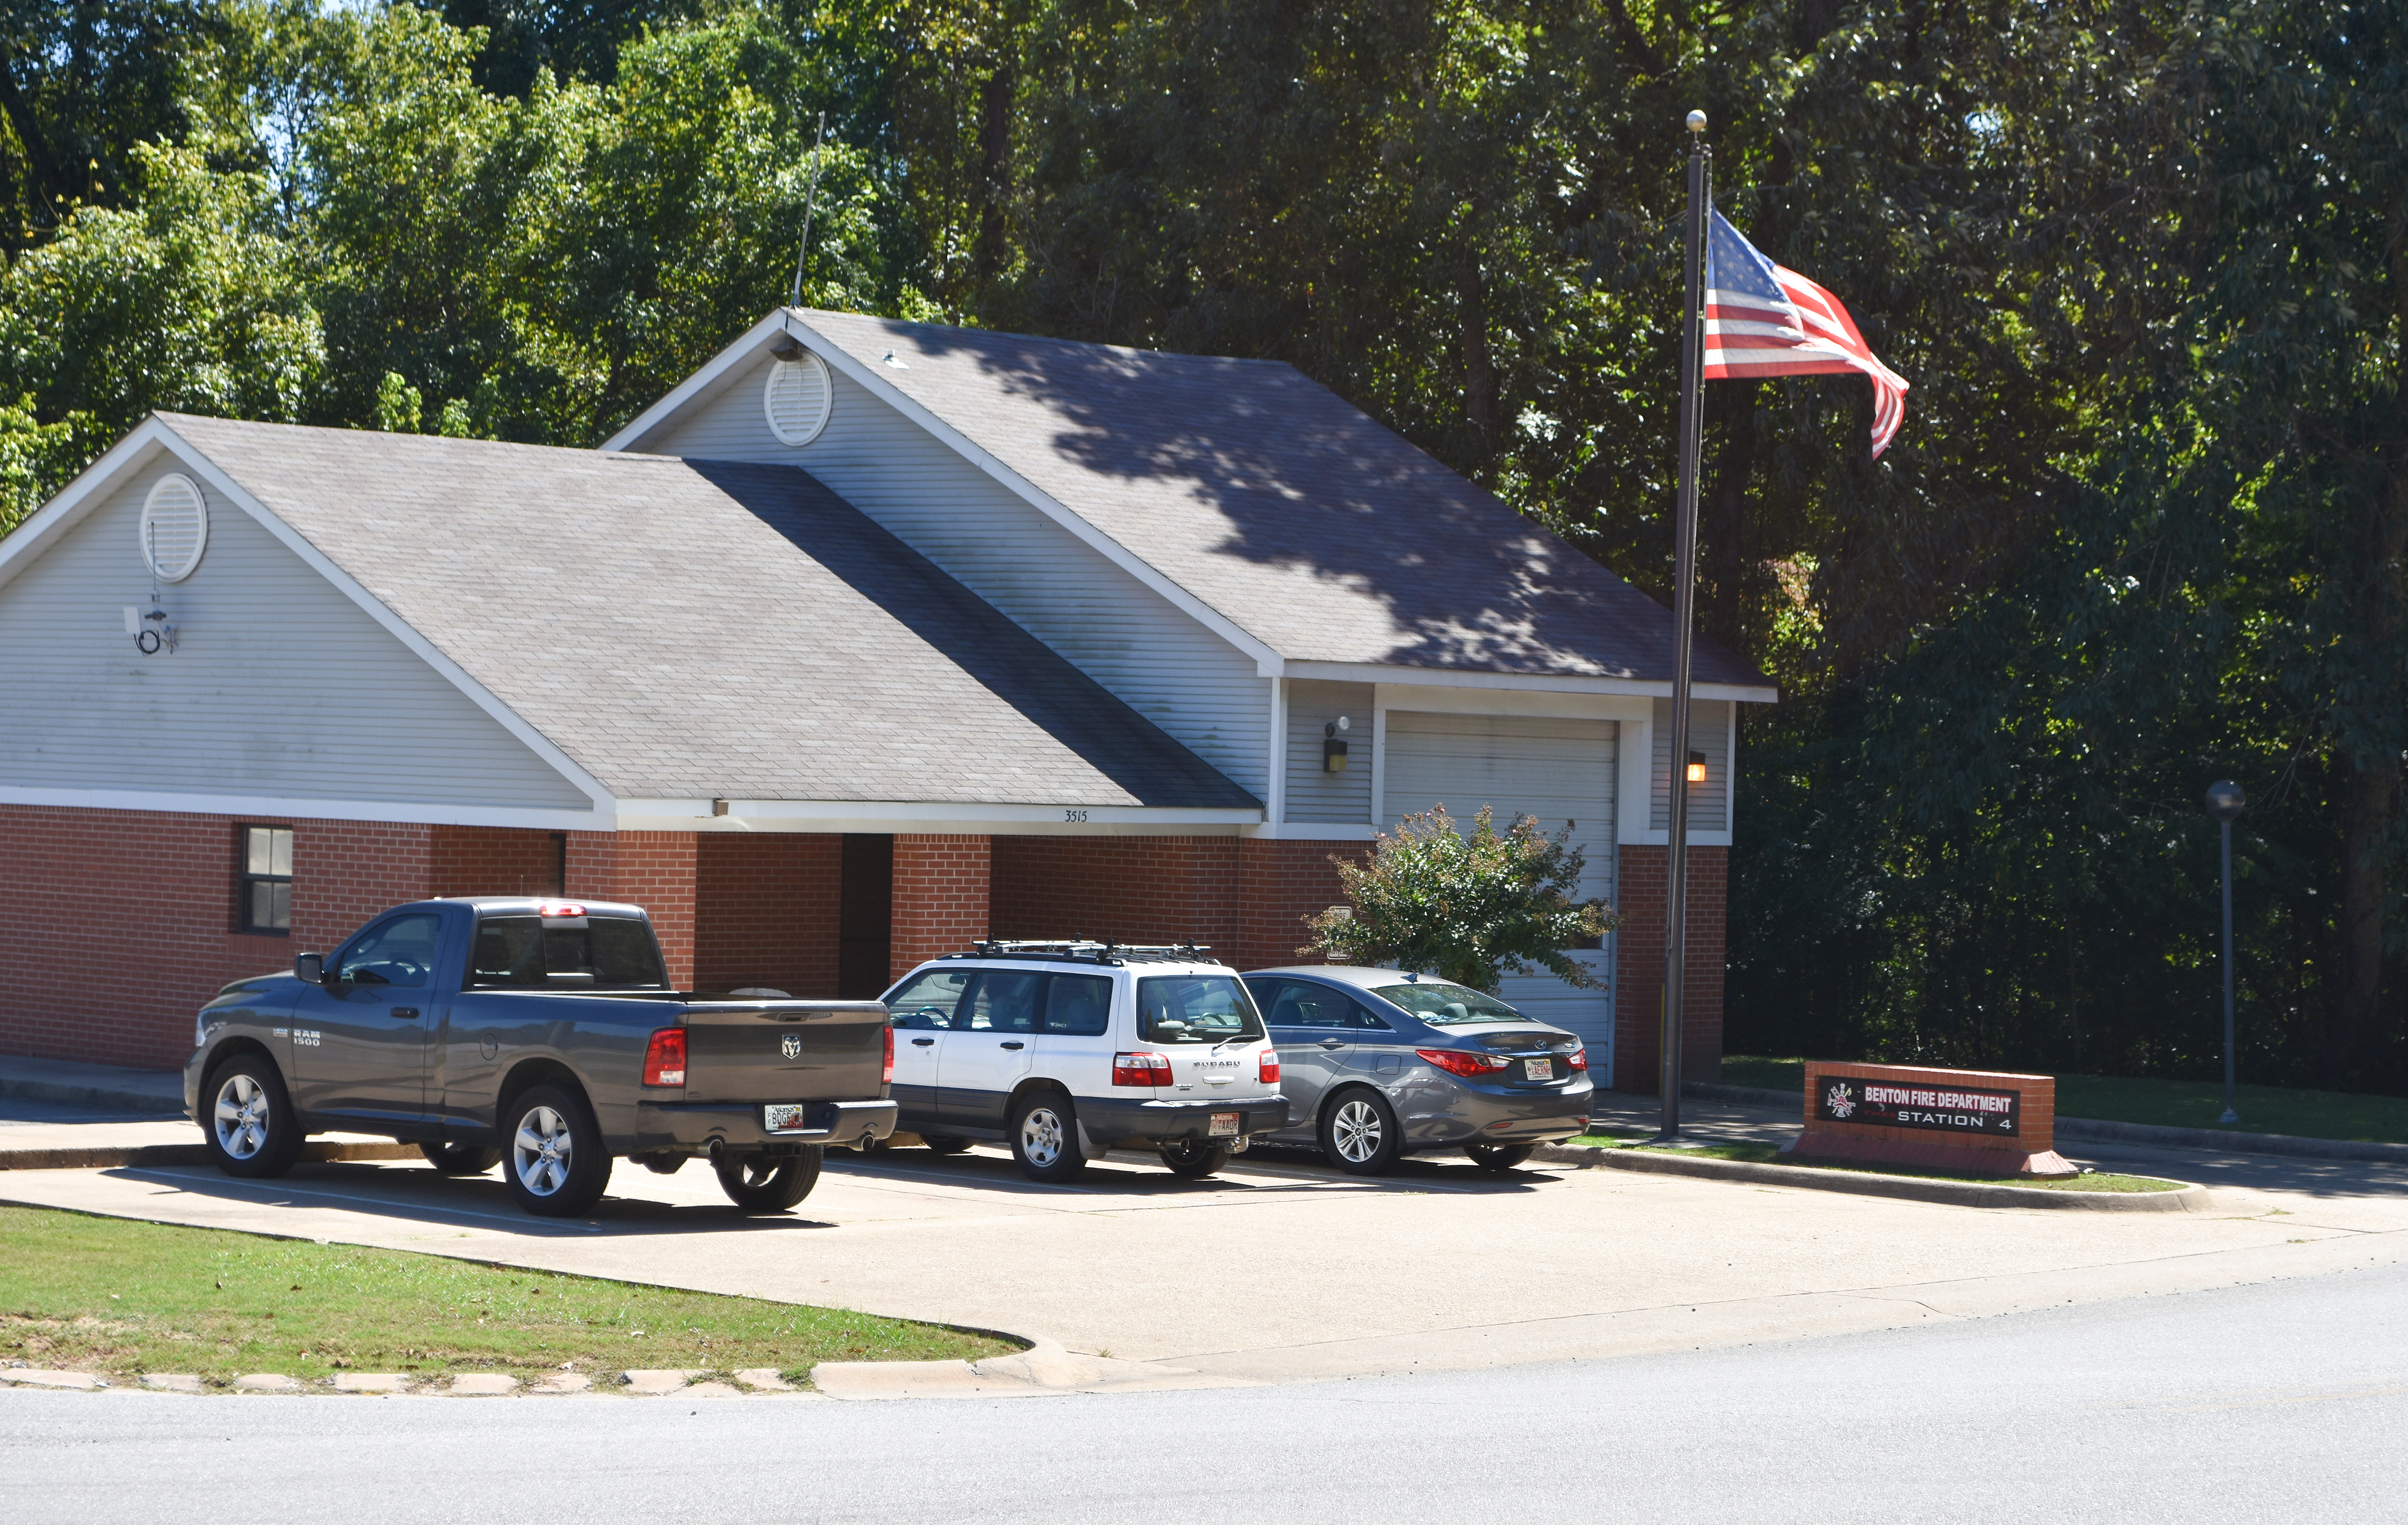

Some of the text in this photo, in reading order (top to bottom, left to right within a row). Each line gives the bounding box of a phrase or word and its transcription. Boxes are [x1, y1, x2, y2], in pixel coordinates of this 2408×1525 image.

[1064, 810, 1087, 822] 3515
[294, 1029, 320, 1039] RAM
[294, 1037, 320, 1046] 1500
[1865, 1086, 2012, 1113] BENTON FIRE DEPARTMENT
[1898, 1111, 2012, 1129] STATION 4
